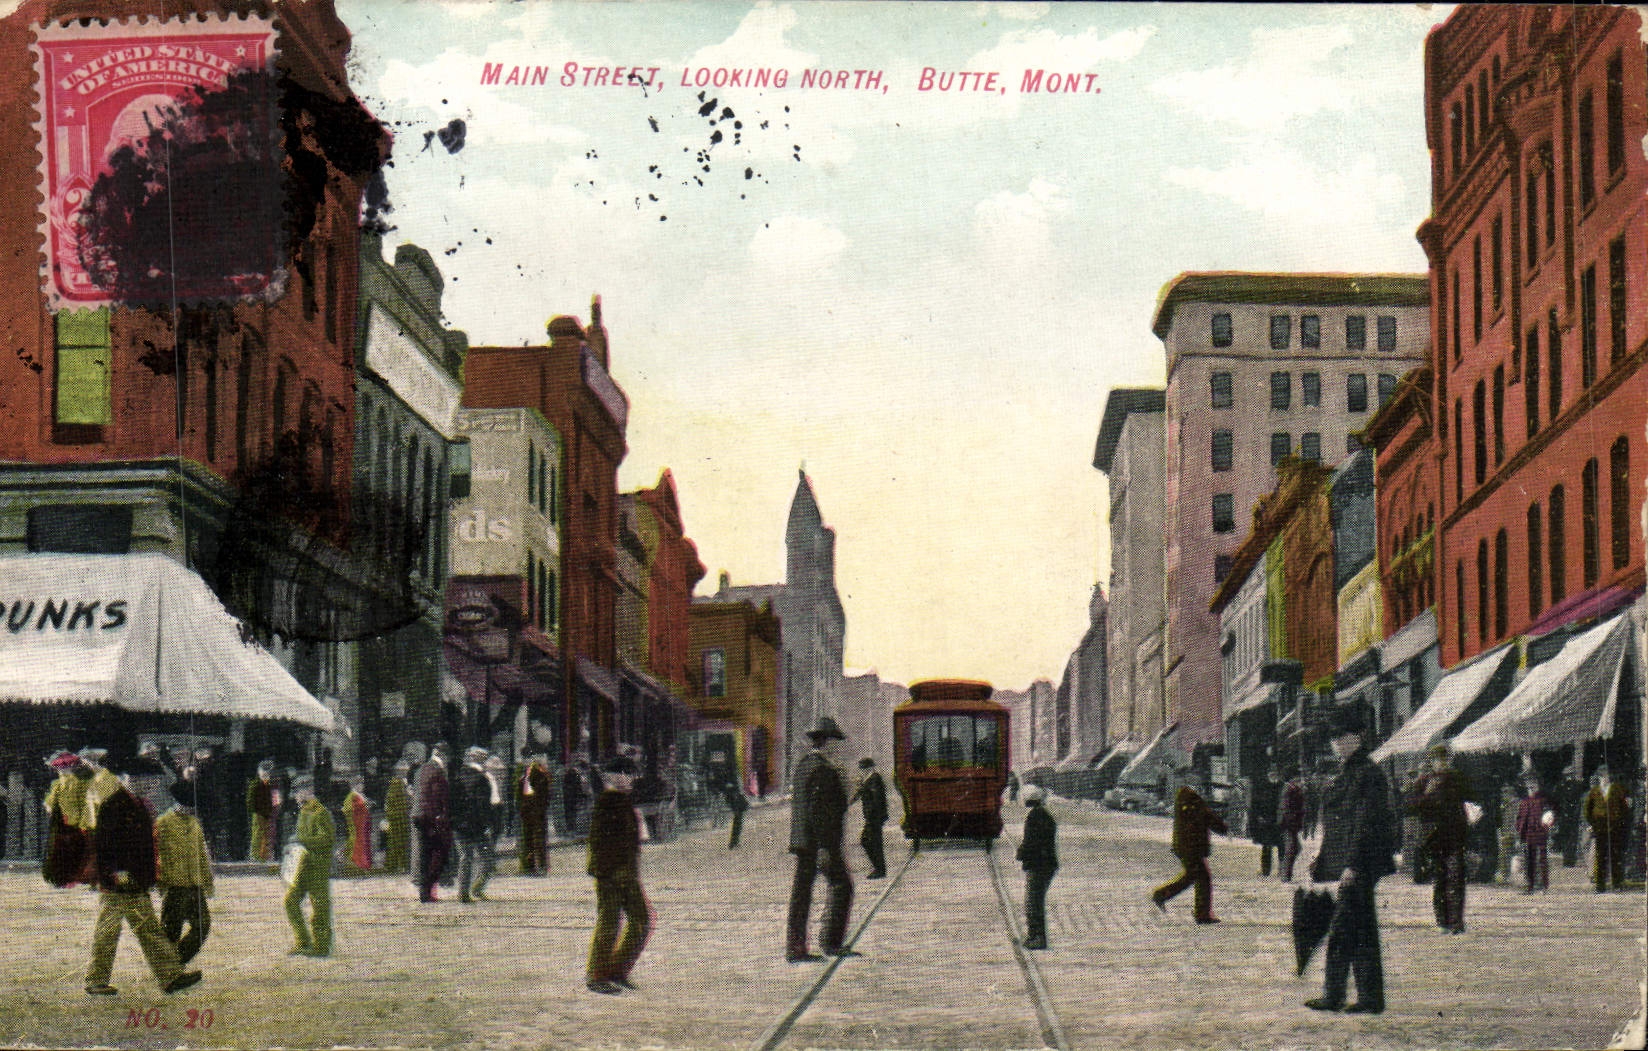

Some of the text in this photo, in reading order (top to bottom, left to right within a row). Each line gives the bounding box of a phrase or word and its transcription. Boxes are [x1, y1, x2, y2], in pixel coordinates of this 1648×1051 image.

[60, 46, 153, 90] UNITED
[77, 59, 228, 95] OF AMERICA
[0, 599, 128, 634] UNKS
